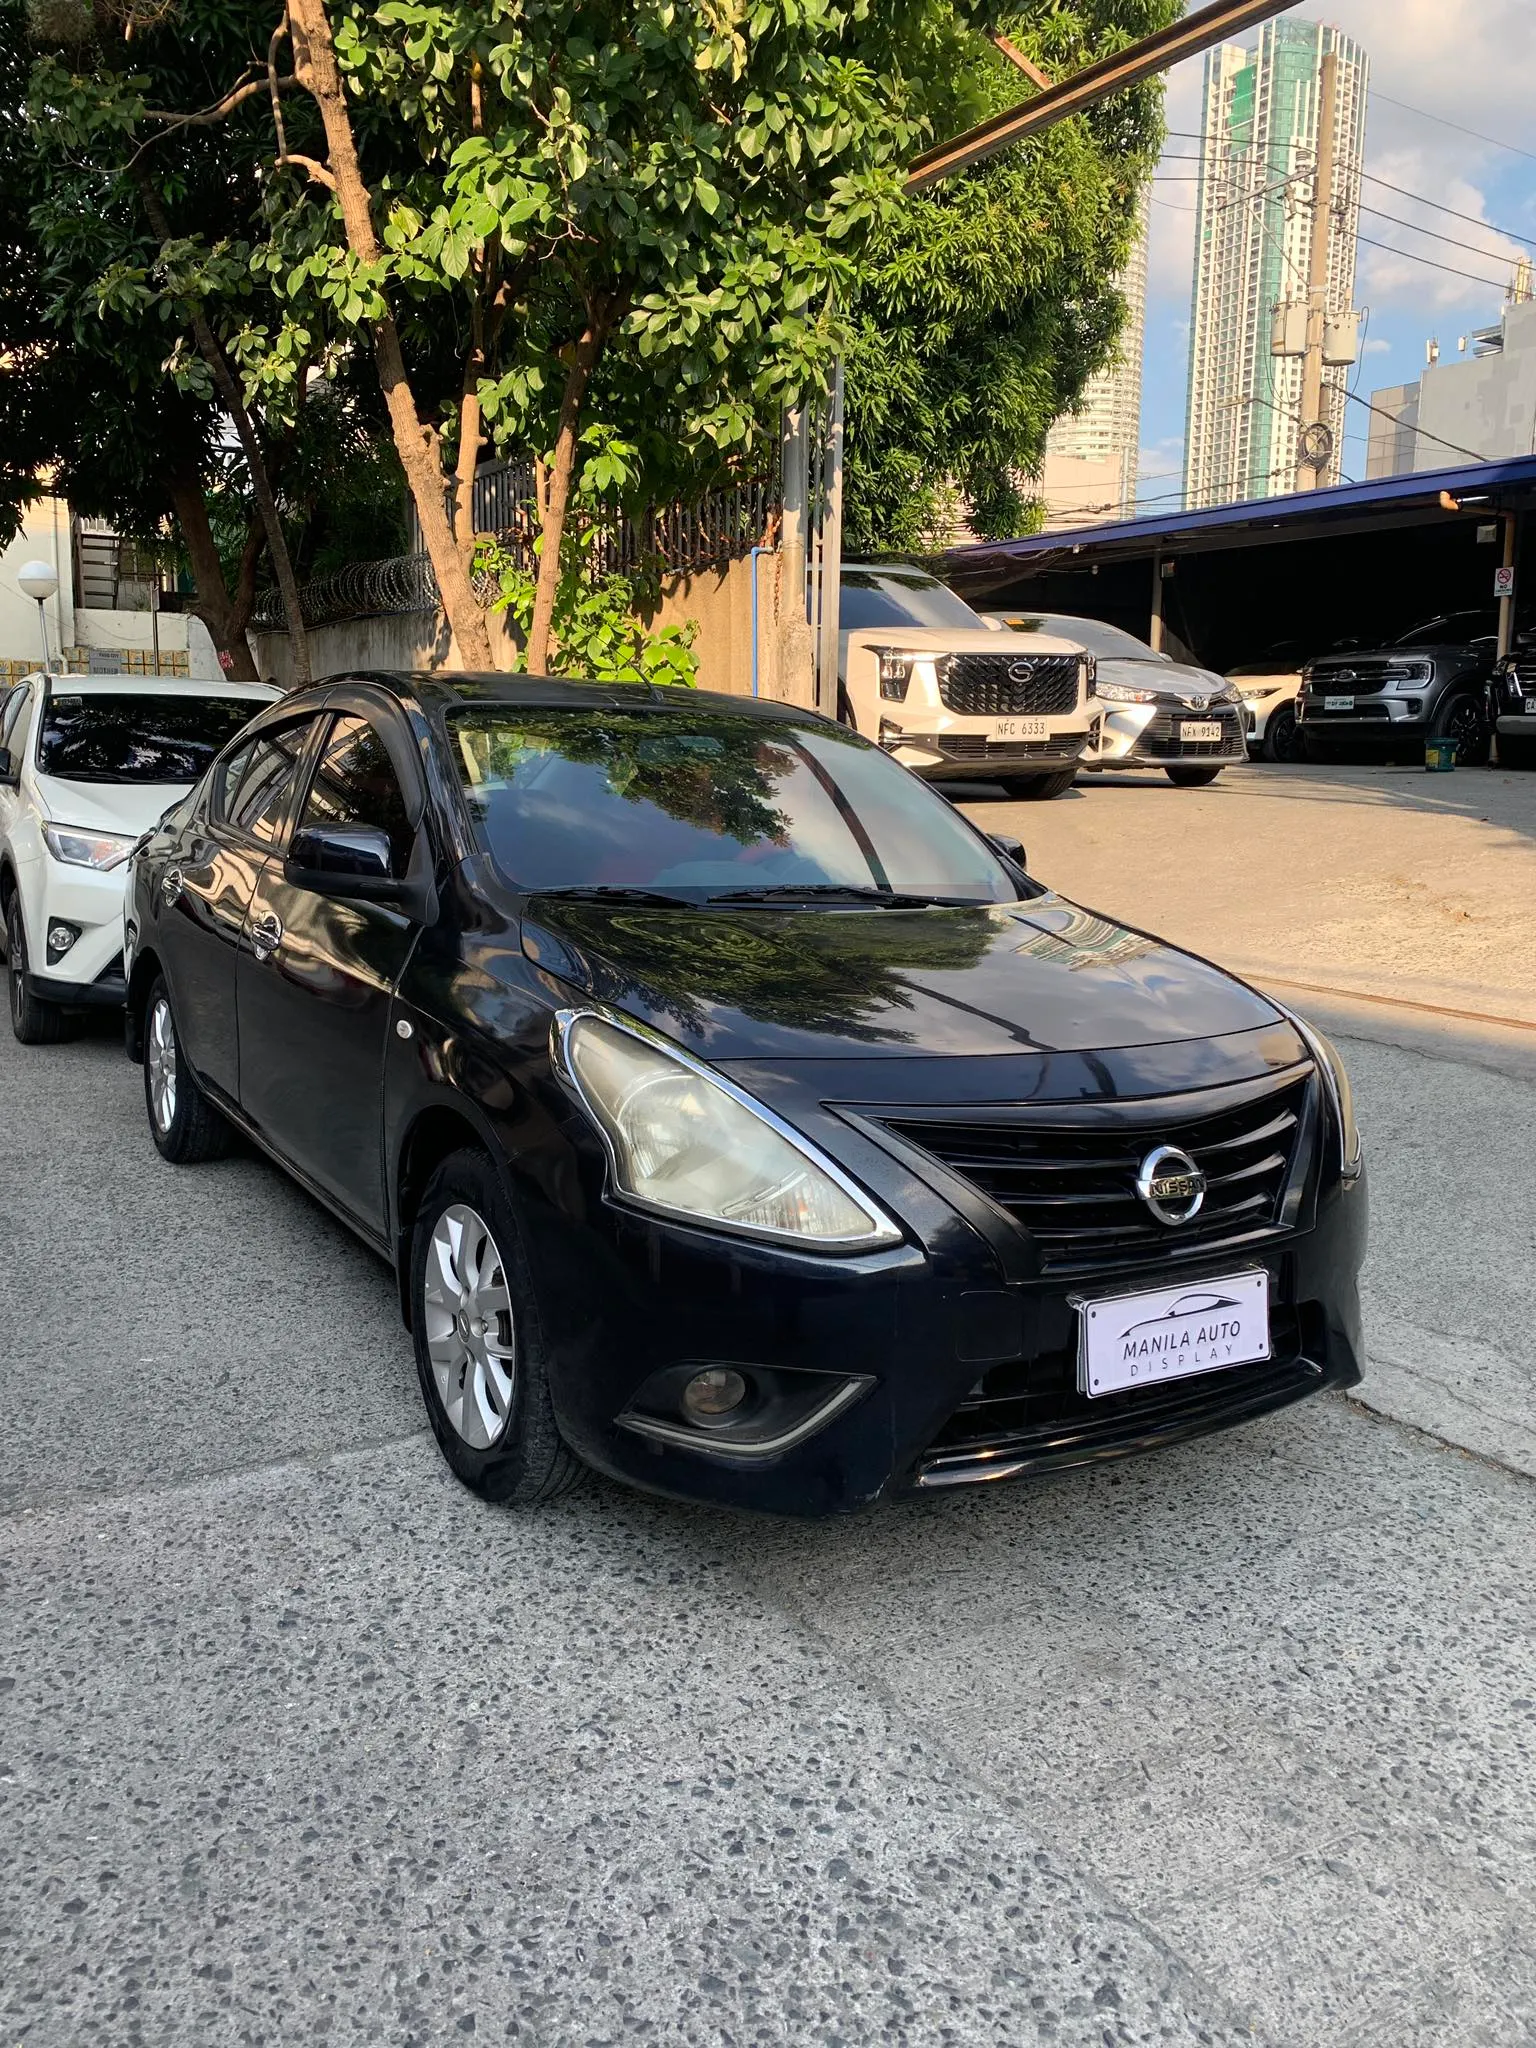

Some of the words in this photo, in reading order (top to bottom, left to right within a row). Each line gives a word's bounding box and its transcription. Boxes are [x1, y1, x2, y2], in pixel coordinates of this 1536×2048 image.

[998, 722, 1015, 735] NFC
[1021, 722, 1045, 735] 6333
[1201, 726, 1220, 737] 9142
[1150, 1177, 1204, 1196] NISSAN
[1123, 1331, 1190, 1360] MANILA
[1196, 1320, 1241, 1345] AUTO
[1130, 1344, 1233, 1377] DISPLAY
